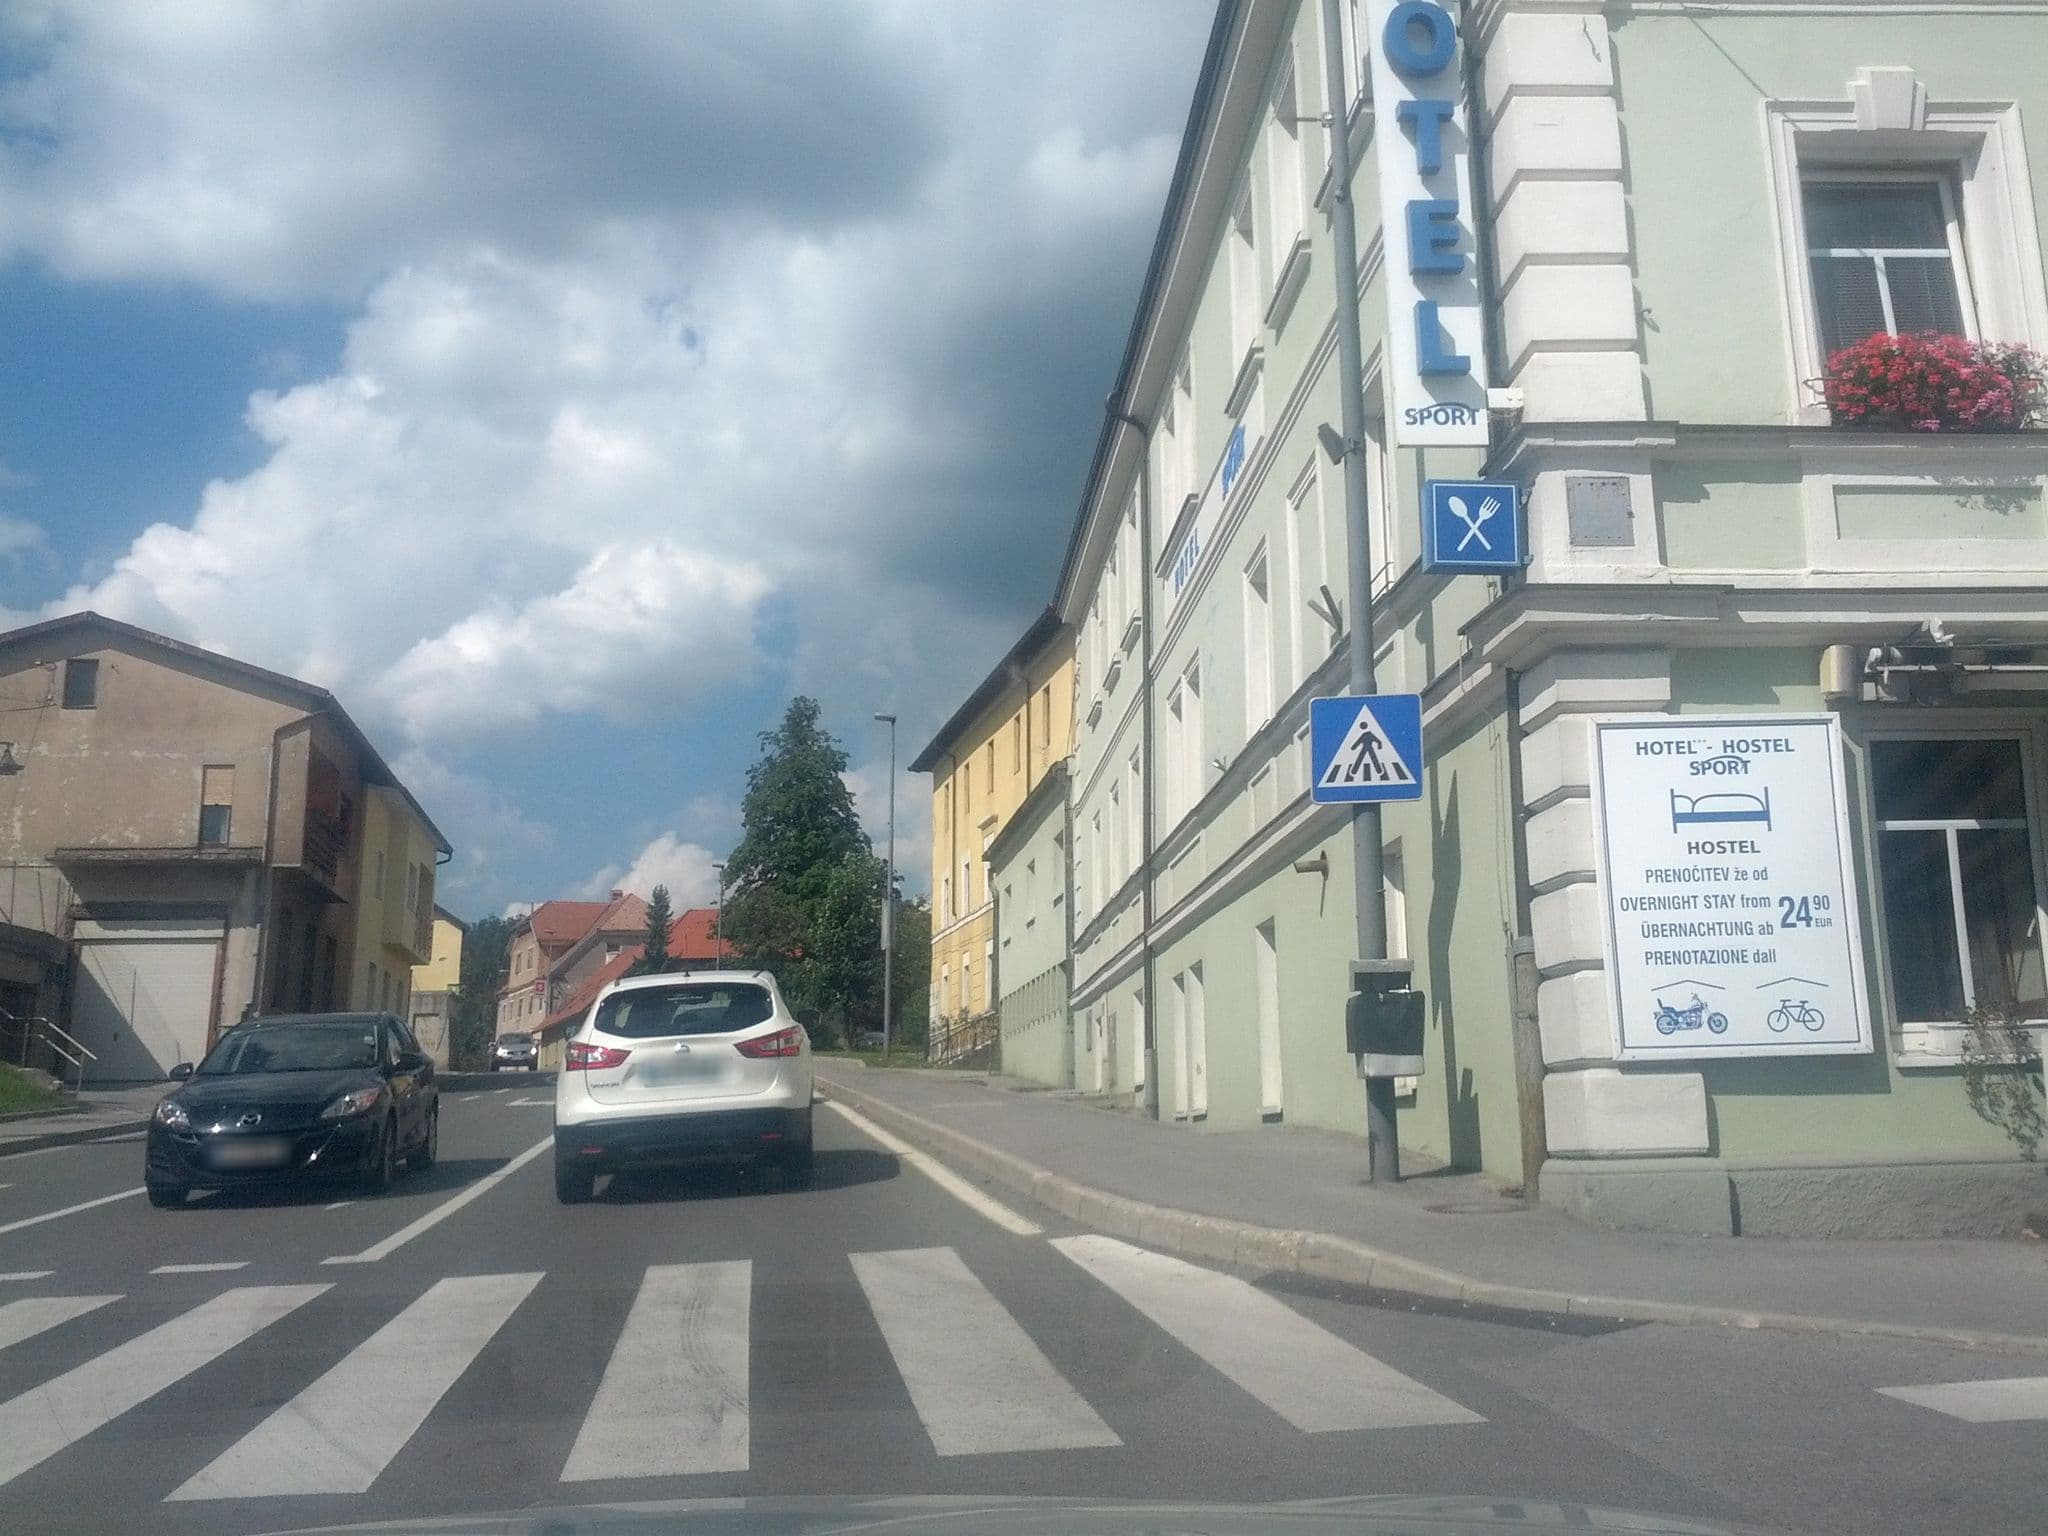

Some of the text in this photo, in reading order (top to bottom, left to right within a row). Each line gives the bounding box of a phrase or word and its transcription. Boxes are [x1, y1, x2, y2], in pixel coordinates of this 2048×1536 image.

[1404, 406, 1480, 426] SPORT
[1174, 527, 1200, 598] HOTEL
[1636, 740, 1698, 756] HOTEL
[1722, 738, 1795, 754] HOSTEL
[1689, 760, 1751, 776] SPORT
[1687, 840, 1761, 855] HOSTEL
[1645, 865, 1769, 883] PRENOČITEV že od
[1620, 894, 1771, 912] OVERNIGHT STAY from
[1778, 895, 1813, 929] 24
[1815, 917, 1833, 928] EUR
[1641, 920, 1774, 939] ÜBERNACHTUNG ab
[1645, 948, 1777, 966] PRENOTAZIONE dall
